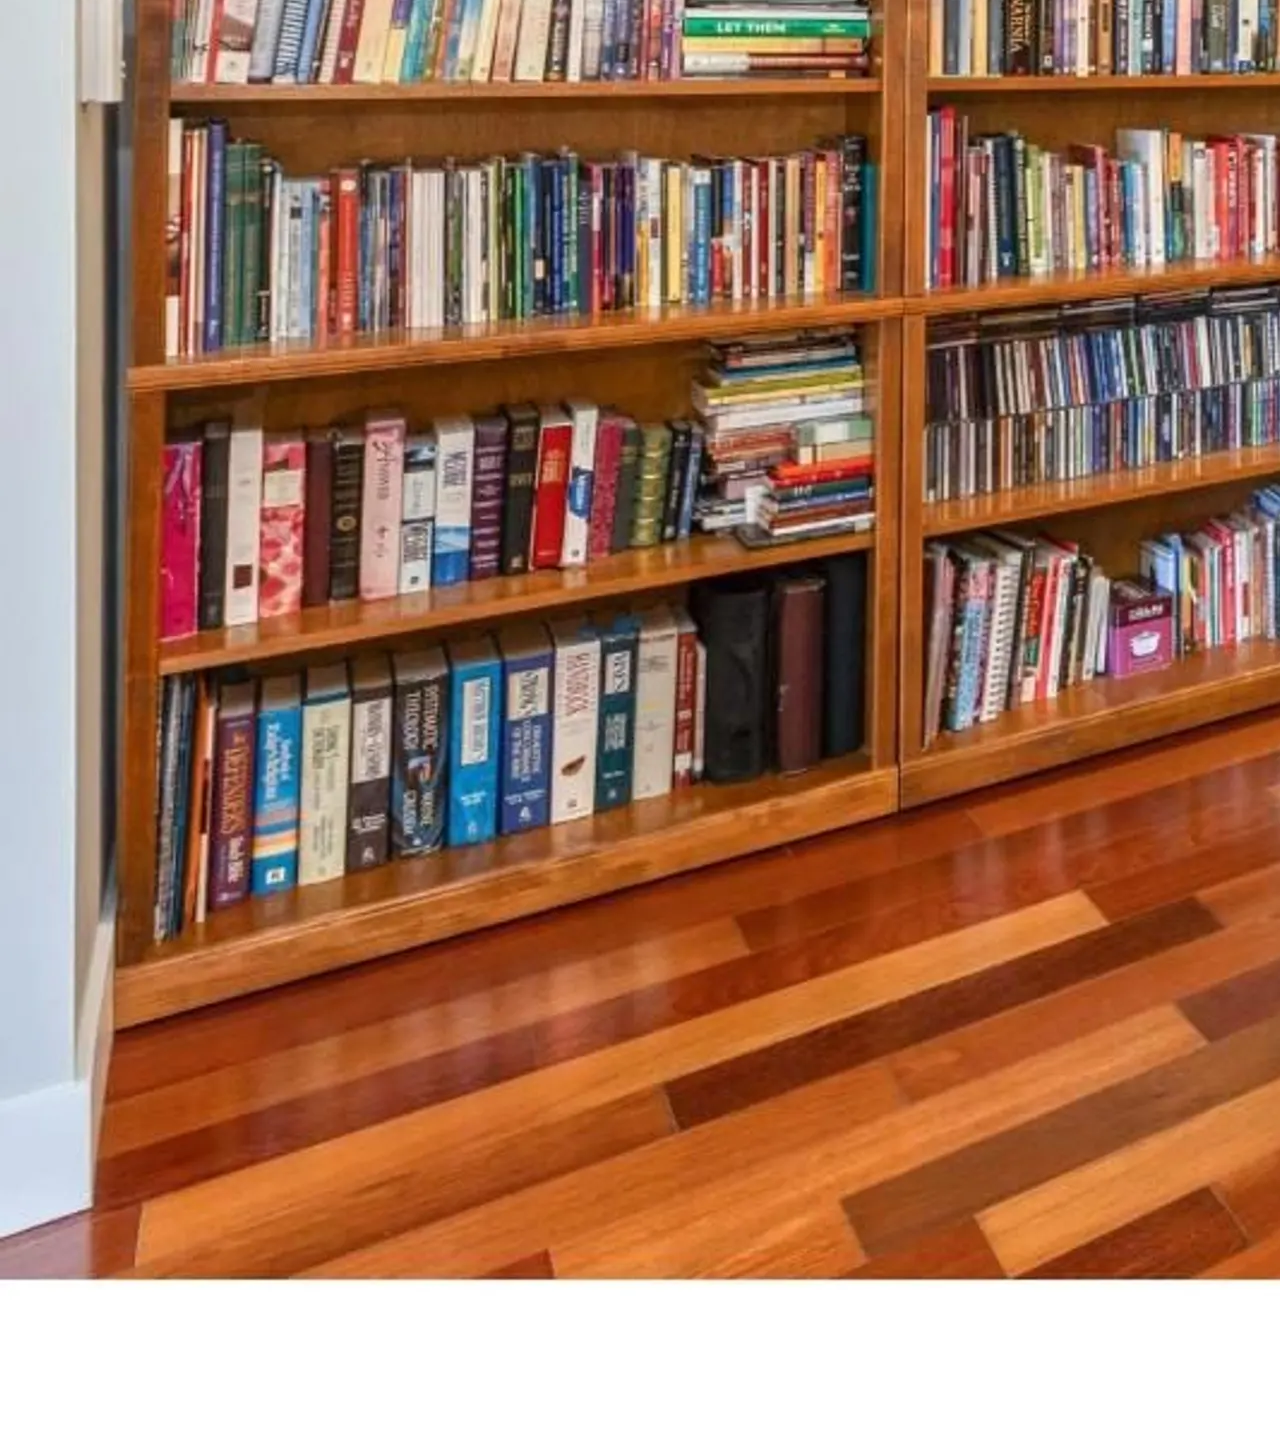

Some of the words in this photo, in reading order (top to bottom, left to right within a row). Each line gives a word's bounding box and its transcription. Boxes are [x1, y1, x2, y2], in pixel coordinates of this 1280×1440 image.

[716, 21, 741, 35] LET
[747, 21, 787, 35] THEM
[403, 692, 422, 750] THEOLOGY
[423, 685, 440, 752] SYSTEMATIC
